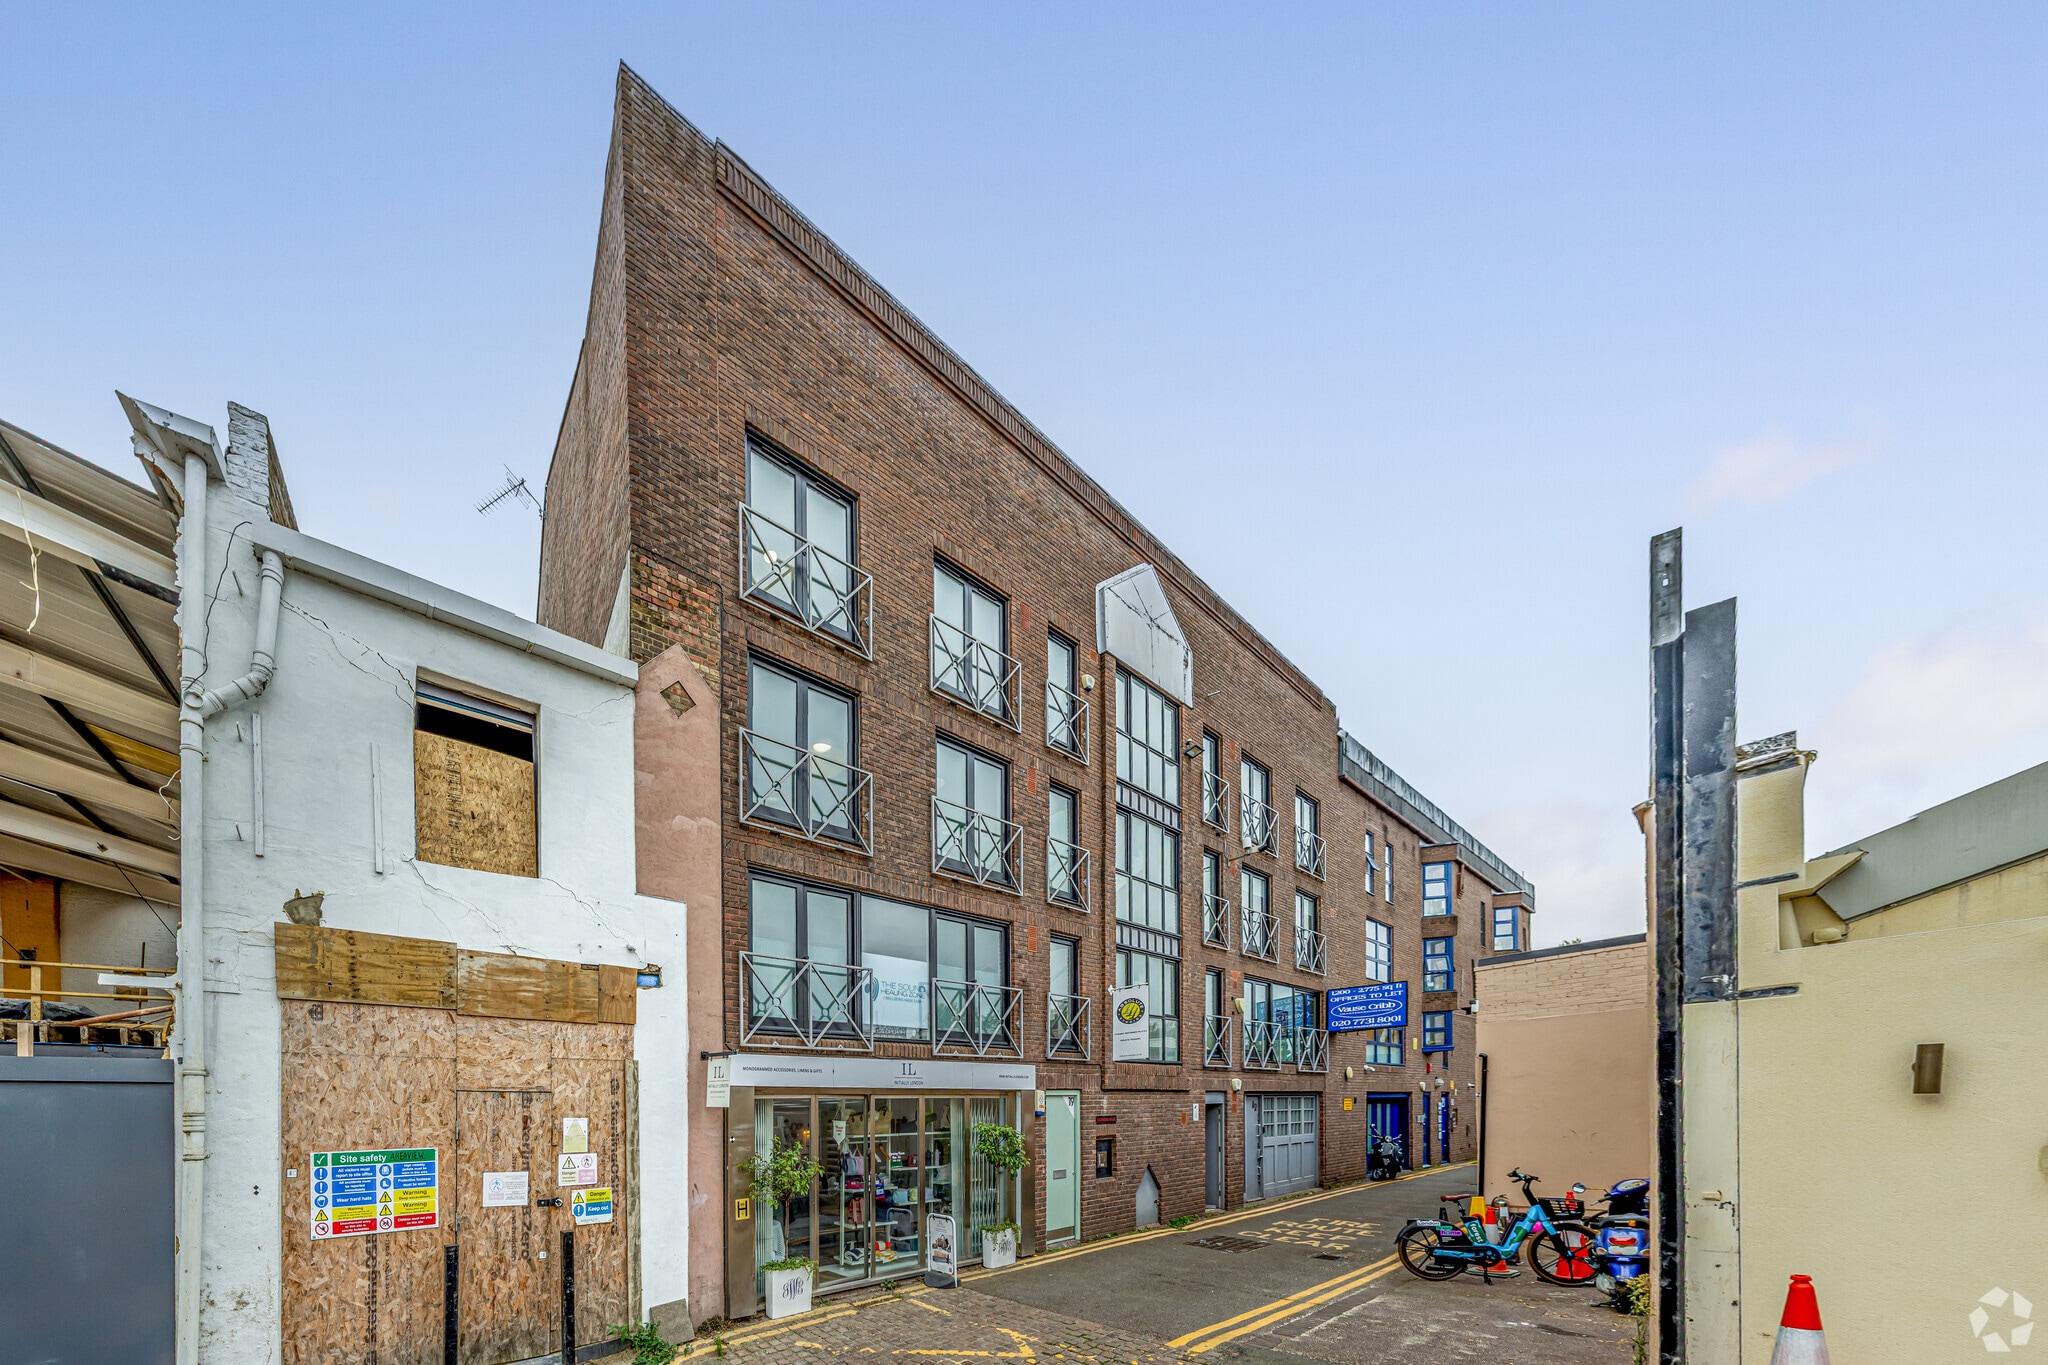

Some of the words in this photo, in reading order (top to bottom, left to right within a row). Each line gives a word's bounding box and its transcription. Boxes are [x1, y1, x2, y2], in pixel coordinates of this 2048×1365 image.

[881, 981, 896, 989] THE
[898, 983, 926, 992] SOUND
[881, 989, 908, 998] HEALING
[909, 991, 926, 999] ZONE
[1330, 994, 1366, 1002] OFFICES
[1118, 998, 1144, 1011] ABSOLUTE
[714, 1066, 724, 1078] IL
[902, 1063, 916, 1075] IL
[1068, 1096, 1074, 1106] 19
[340, 1155, 357, 1163] Site
[360, 1153, 386, 1164] safety
[738, 1200, 747, 1218] H
[1272, 1221, 1383, 1237] ROUTE
[1307, 1218, 1382, 1229] FIRE
[1264, 1227, 1357, 1240] KEEP
[1470, 1224, 1483, 1242] forest
[522, 1221, 531, 1260] Zero
[1237, 1230, 1350, 1250] CLEAR
